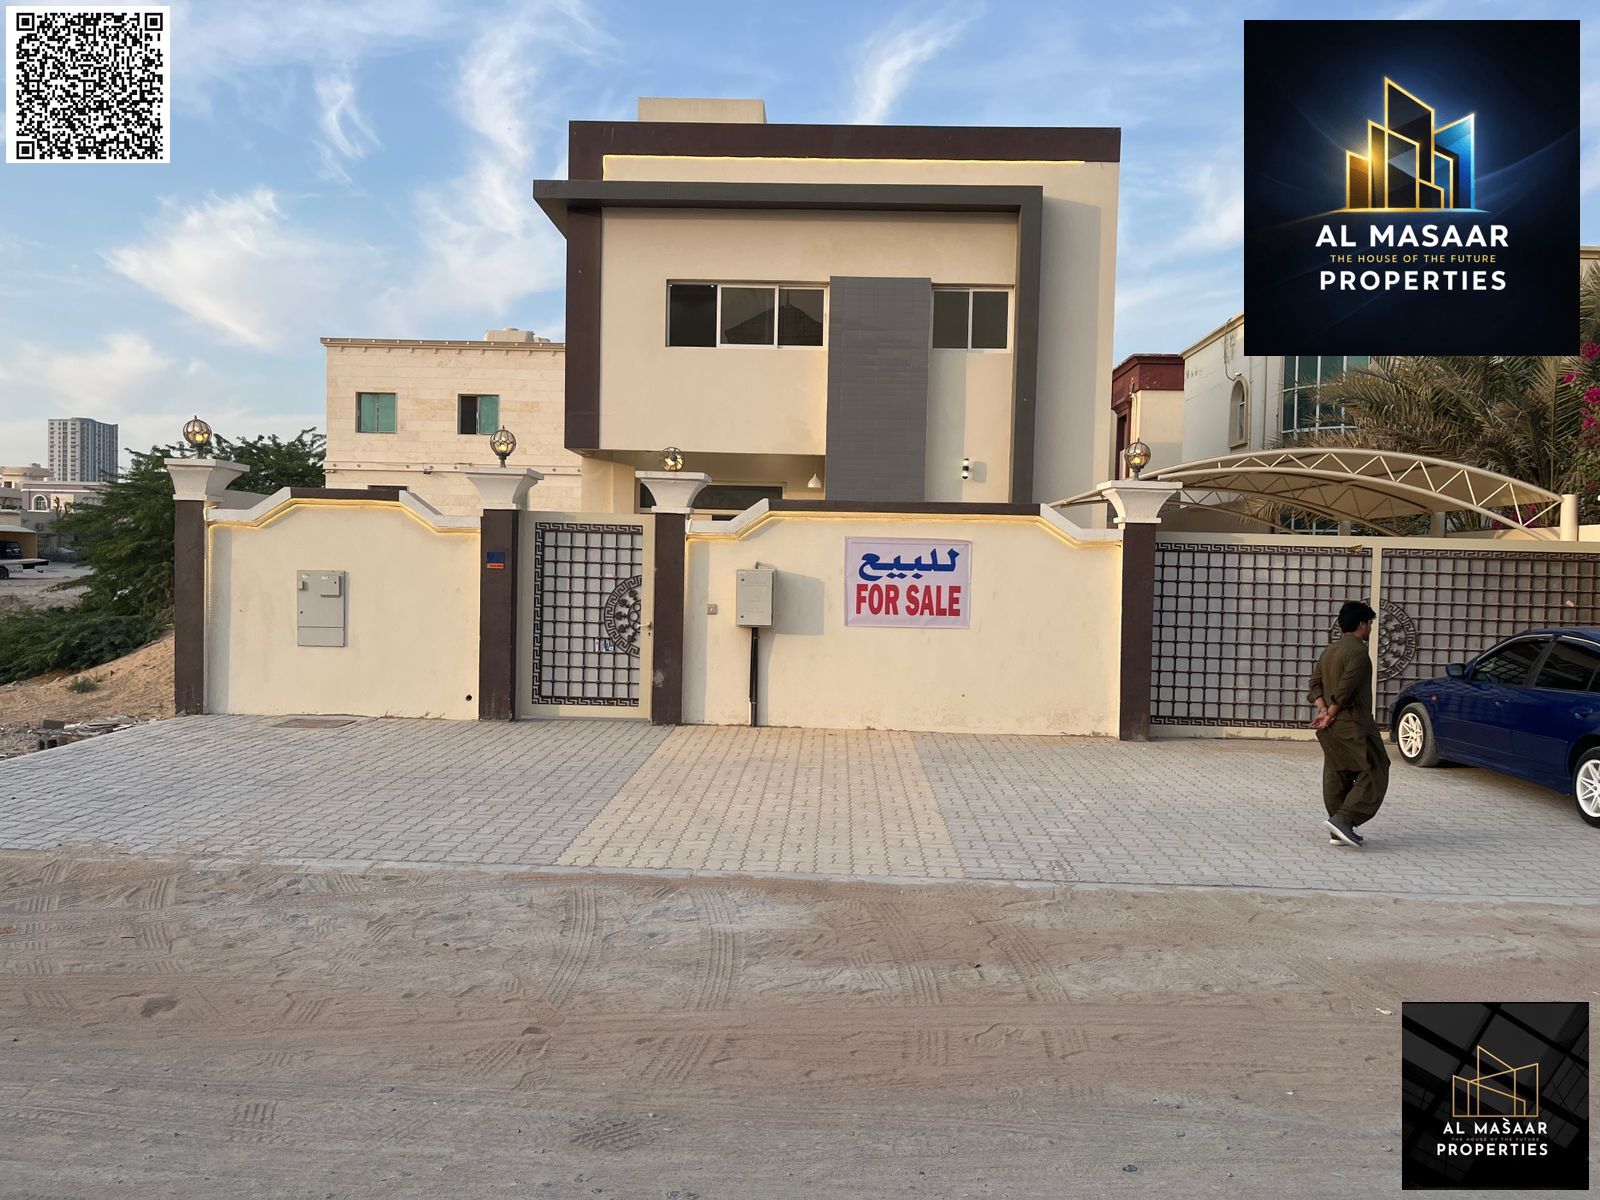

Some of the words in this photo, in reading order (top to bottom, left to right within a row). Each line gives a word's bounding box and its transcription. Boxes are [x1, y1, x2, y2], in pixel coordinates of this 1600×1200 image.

[858, 547, 960, 582] للبيع
[855, 583, 900, 615] FOR
[905, 584, 961, 617] SALE
